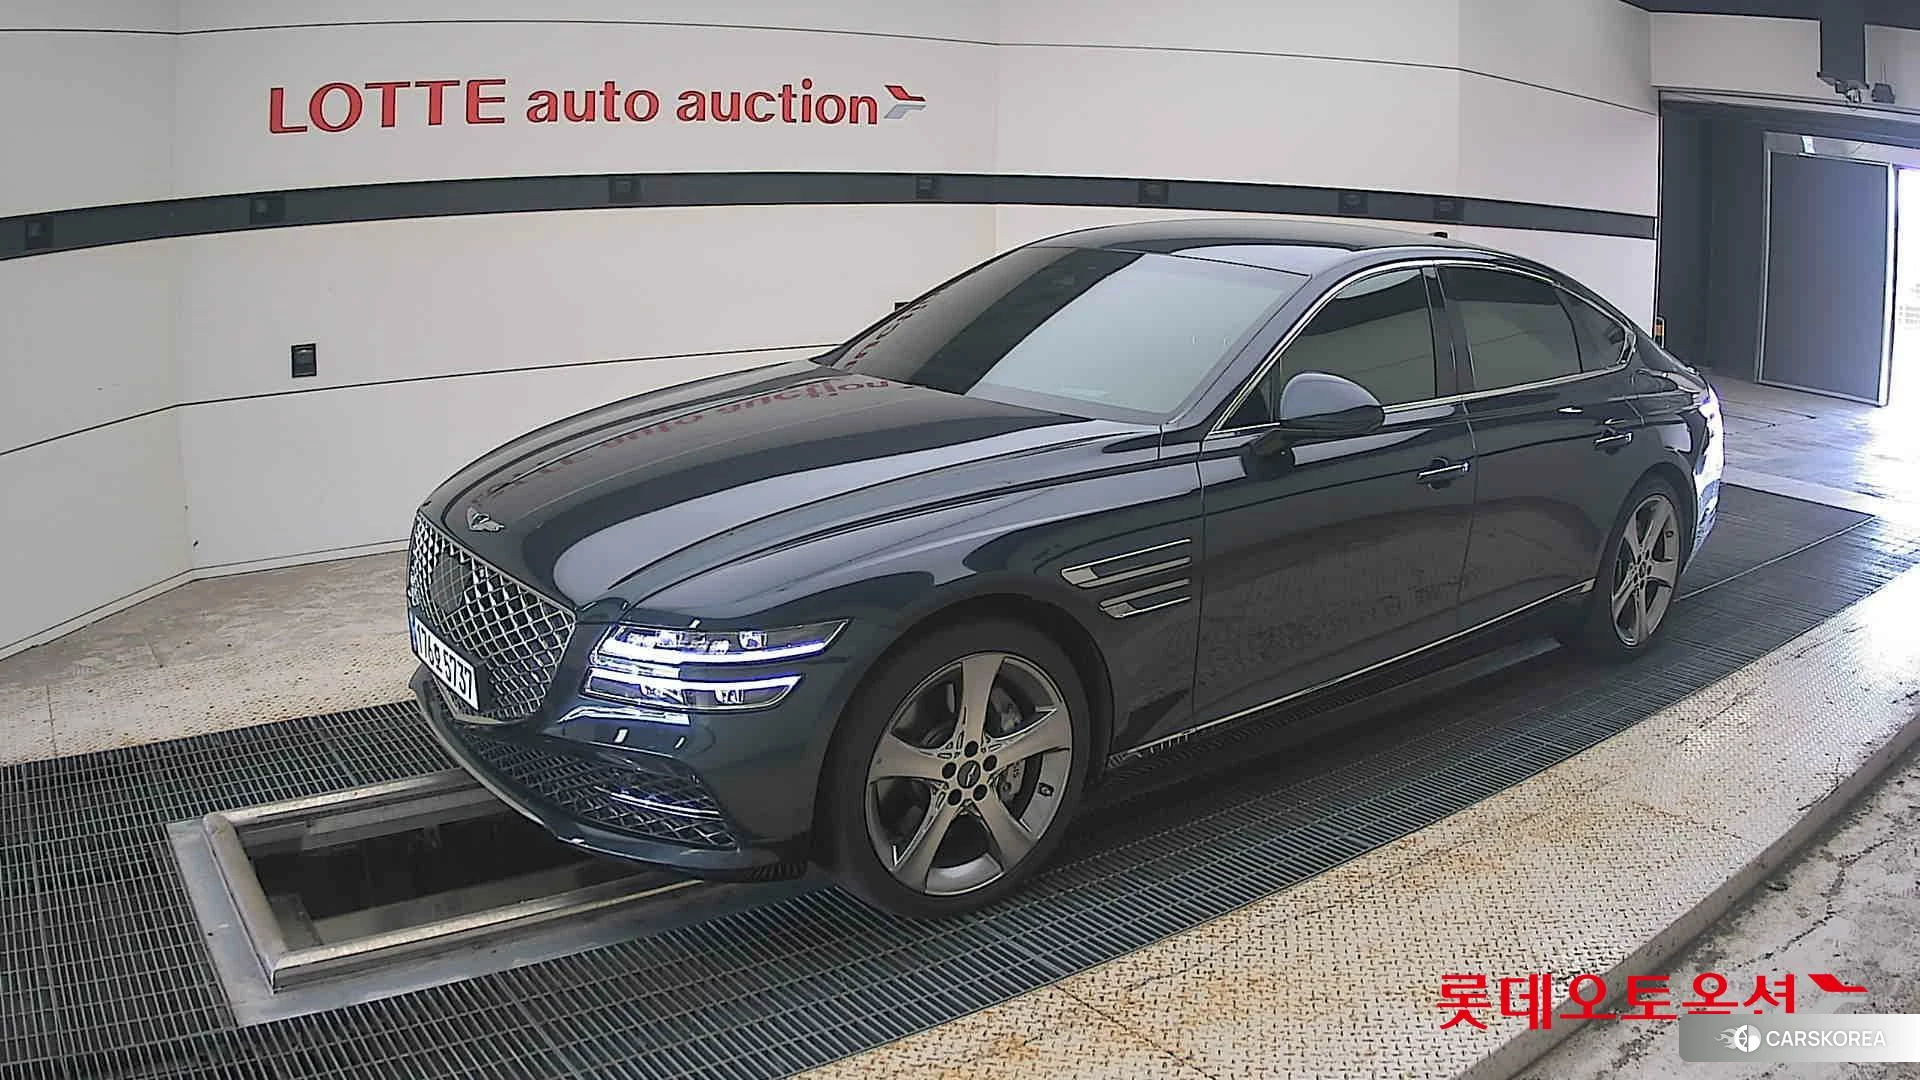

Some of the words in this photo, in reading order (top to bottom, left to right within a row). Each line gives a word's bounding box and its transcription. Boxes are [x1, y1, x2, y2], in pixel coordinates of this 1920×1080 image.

[269, 79, 506, 134] LOTTE
[526, 81, 660, 123] auto
[676, 78, 878, 125] auction
